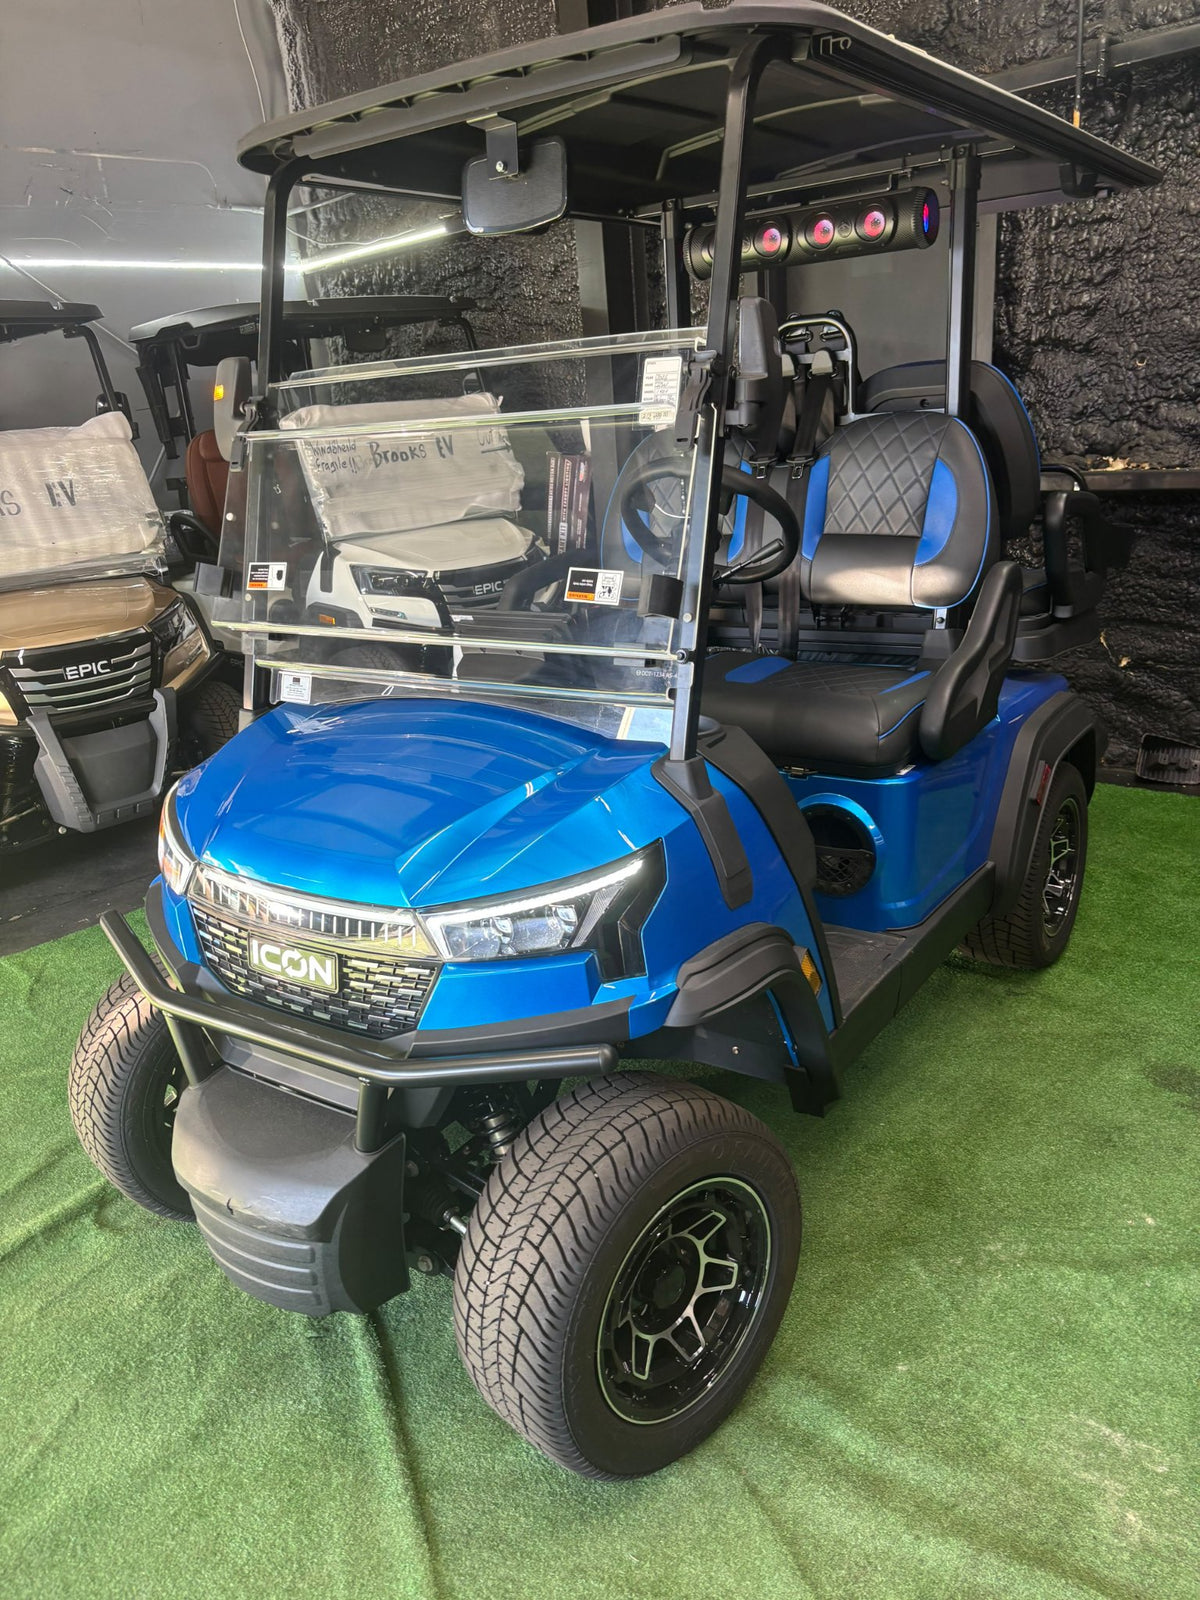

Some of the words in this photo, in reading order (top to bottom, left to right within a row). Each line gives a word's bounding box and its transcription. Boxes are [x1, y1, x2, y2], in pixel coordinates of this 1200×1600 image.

[434, 434, 454, 459] EV
[0, 490, 22, 516] S
[474, 580, 504, 595] EPIC
[65, 660, 111, 680] EPIC
[252, 939, 332, 985] ICON
